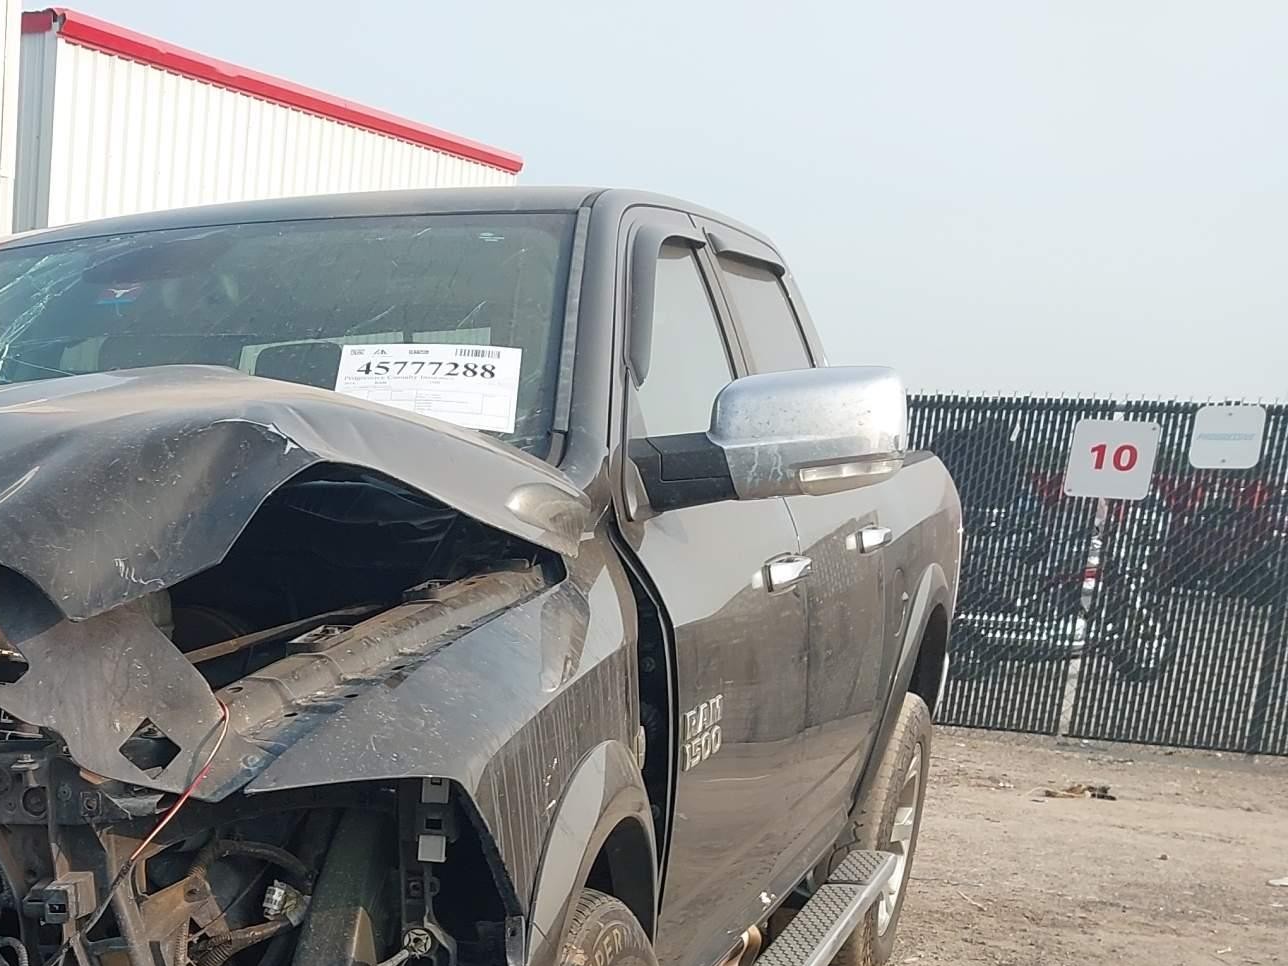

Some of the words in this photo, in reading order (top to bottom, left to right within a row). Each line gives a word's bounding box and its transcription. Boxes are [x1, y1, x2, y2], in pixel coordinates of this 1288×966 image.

[356, 361, 496, 380] 45777288
[1090, 443, 1138, 472] 10
[684, 693, 723, 741] RAM
[683, 725, 723, 772] 1500
